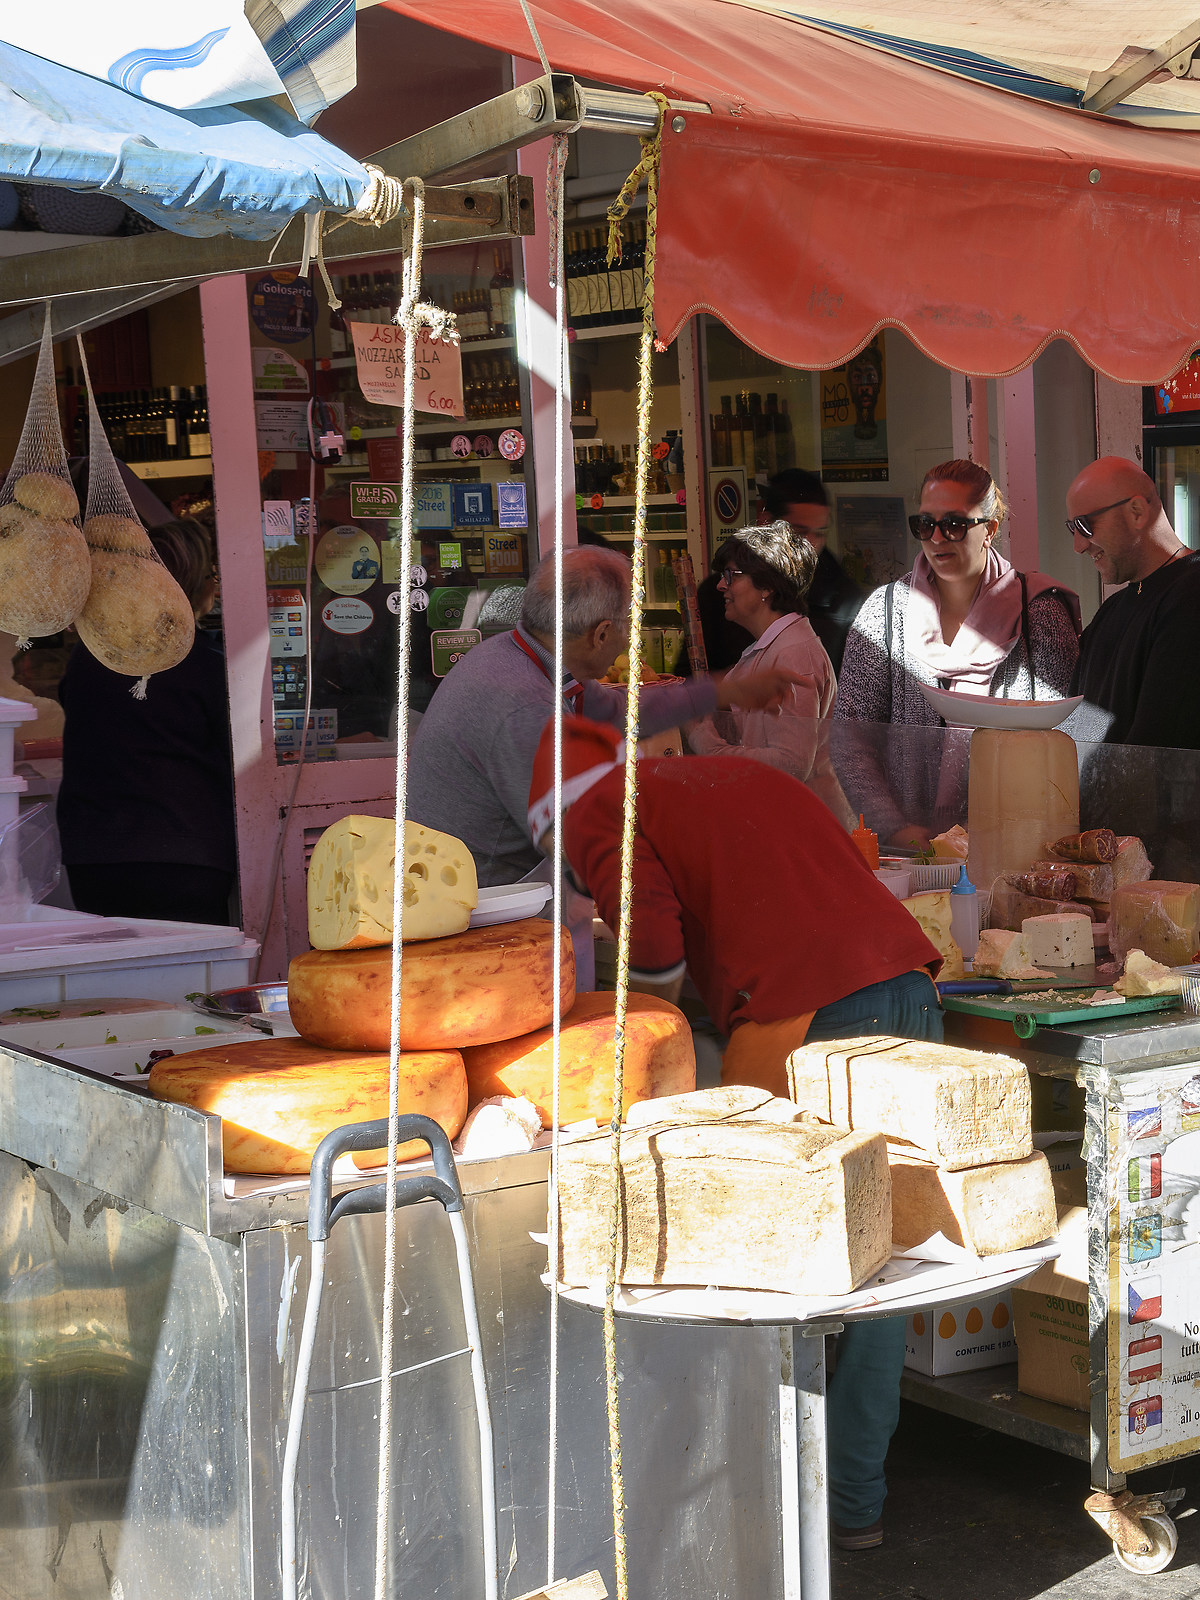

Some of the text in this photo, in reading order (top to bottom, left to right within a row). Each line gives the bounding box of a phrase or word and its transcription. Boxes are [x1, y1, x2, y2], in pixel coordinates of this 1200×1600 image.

[358, 347, 440, 363] MOZZARLLA
[385, 366, 431, 380] SAAD
[356, 487, 380, 496] WI-FI
[421, 487, 443, 499] 2016
[417, 500, 446, 511] Street
[489, 538, 518, 550] Street
[489, 551, 519, 567] FOOD
[437, 635, 477, 645] REVIEW US
[1046, 1295, 1065, 1312] 360
[955, 1343, 996, 1357] CONTIENE
[1180, 1409, 1192, 1425] all
